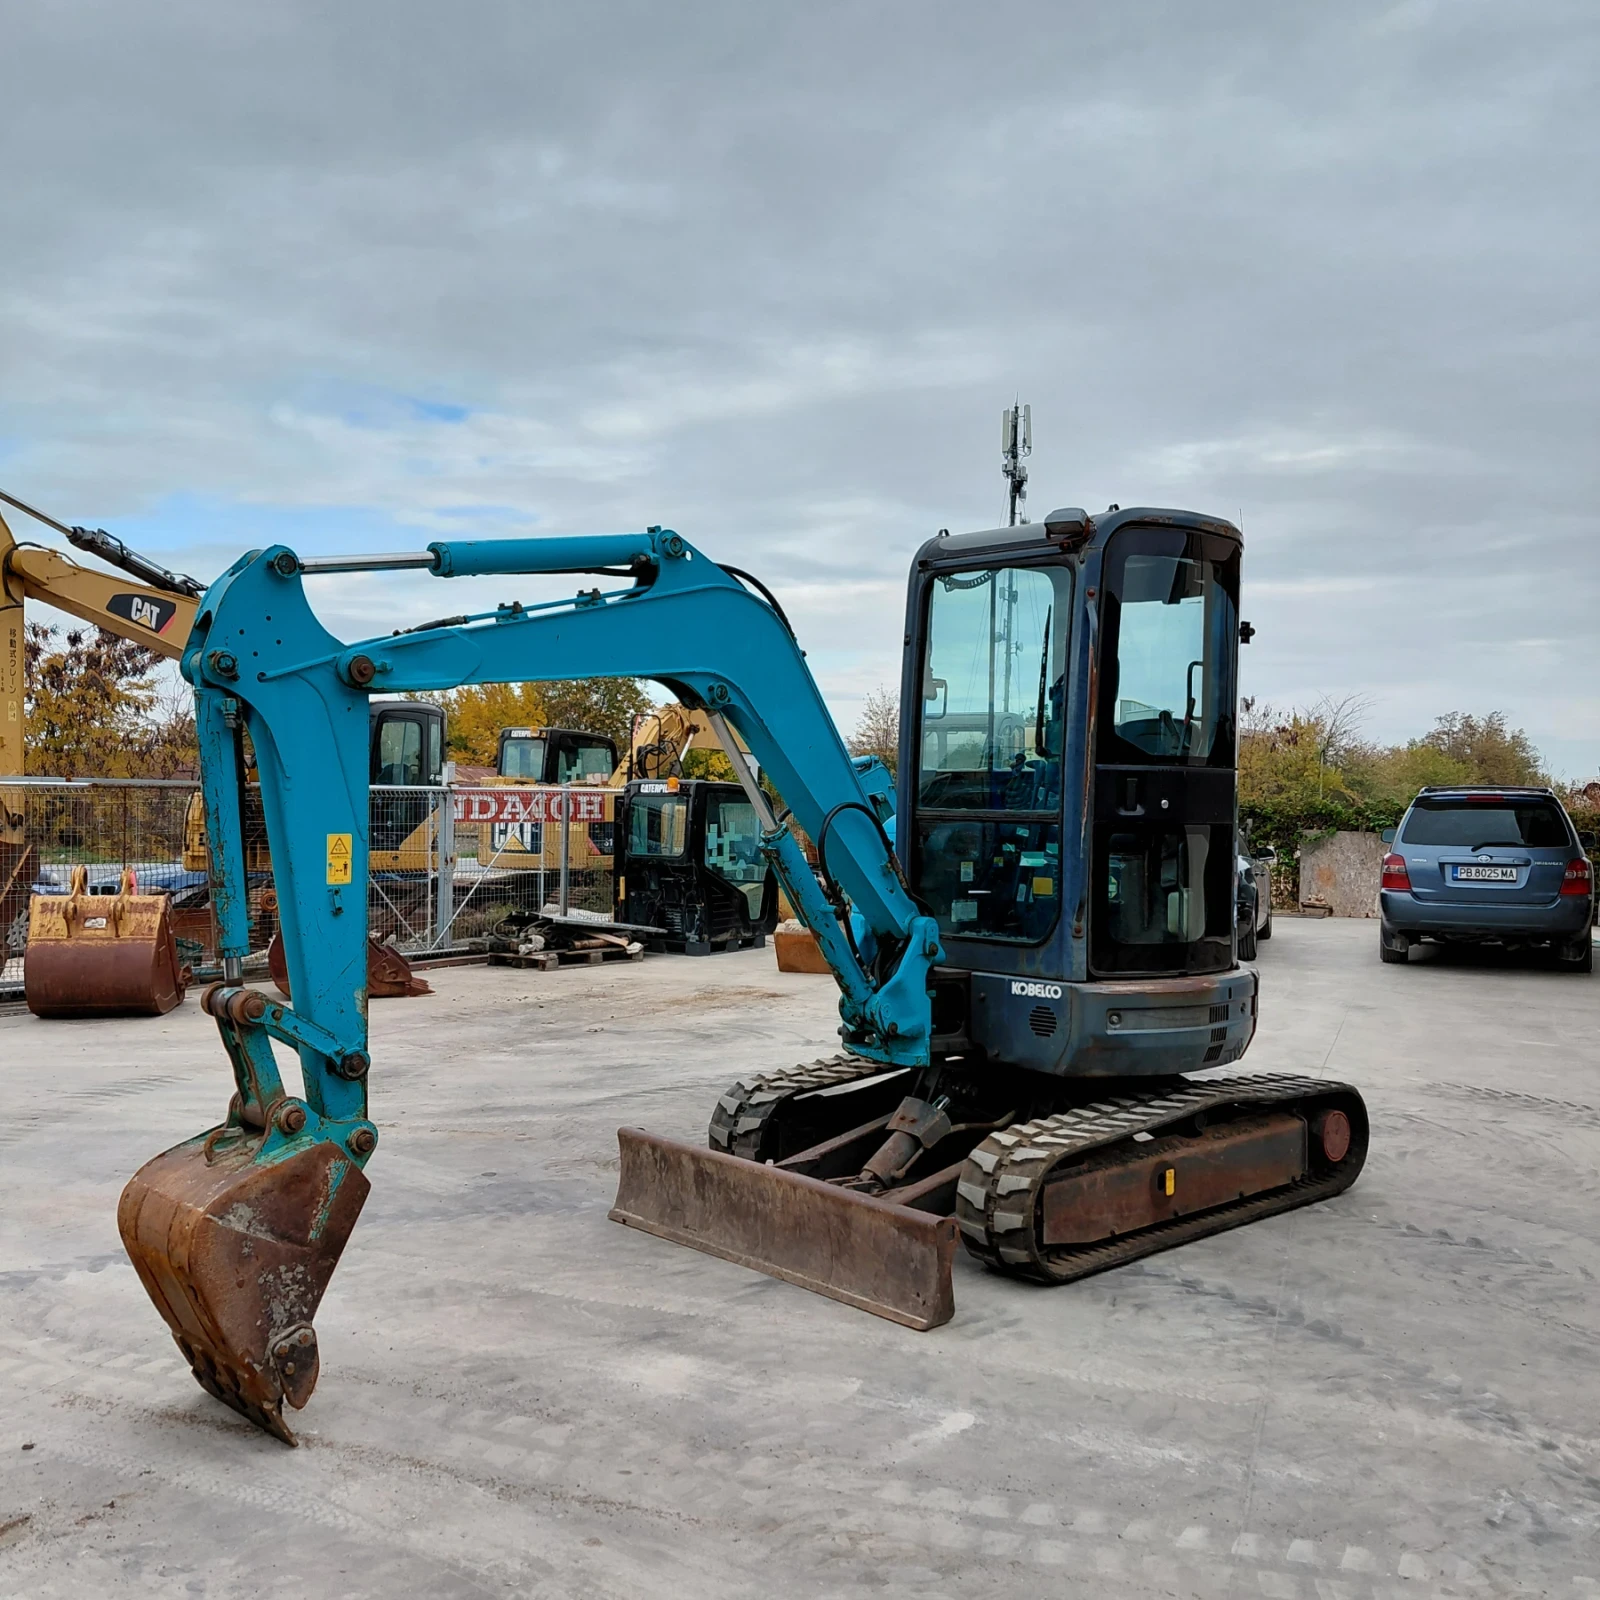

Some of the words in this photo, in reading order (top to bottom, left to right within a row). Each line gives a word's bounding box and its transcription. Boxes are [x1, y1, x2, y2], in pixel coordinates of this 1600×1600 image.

[131, 597, 160, 629] CAT
[9, 628, 17, 694] 移動式クレーン
[1460, 868, 1472, 877] PB
[1475, 868, 1499, 878] 8025
[1501, 869, 1514, 879] MA
[1011, 981, 1062, 999] KOBELCO
